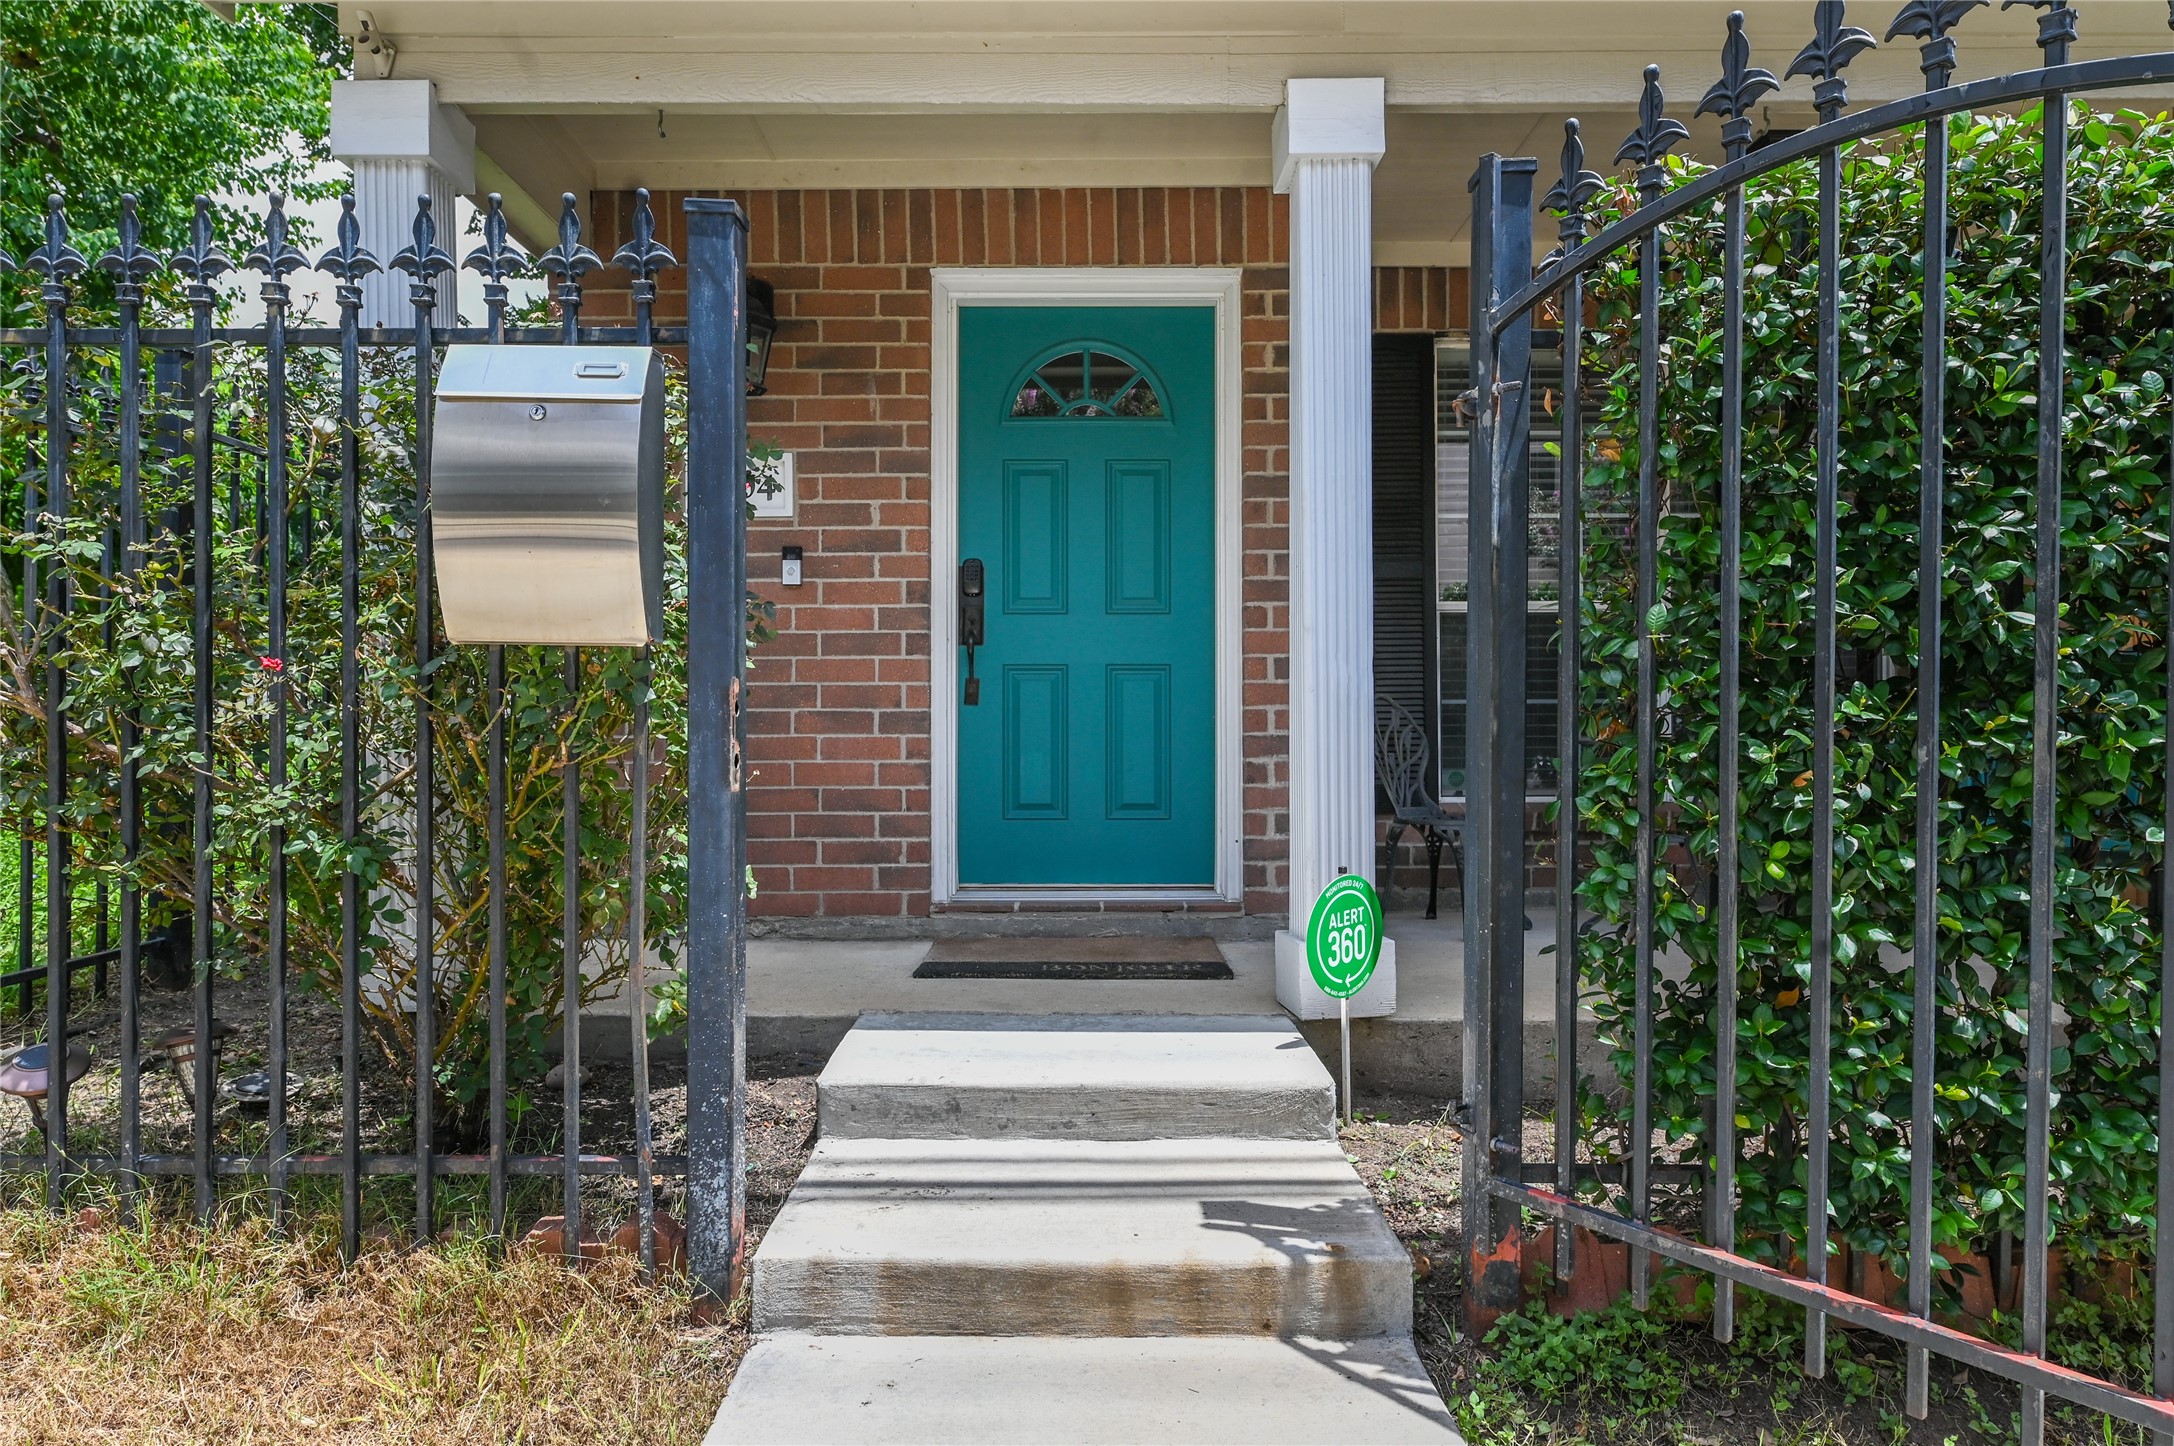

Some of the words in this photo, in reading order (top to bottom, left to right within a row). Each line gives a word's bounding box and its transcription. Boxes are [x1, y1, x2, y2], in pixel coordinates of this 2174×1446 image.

[1325, 879, 1352, 899] MONITORED
[1352, 879, 1364, 890] 24/7
[1329, 906, 1365, 930] ALERT
[1327, 924, 1366, 968] 360
